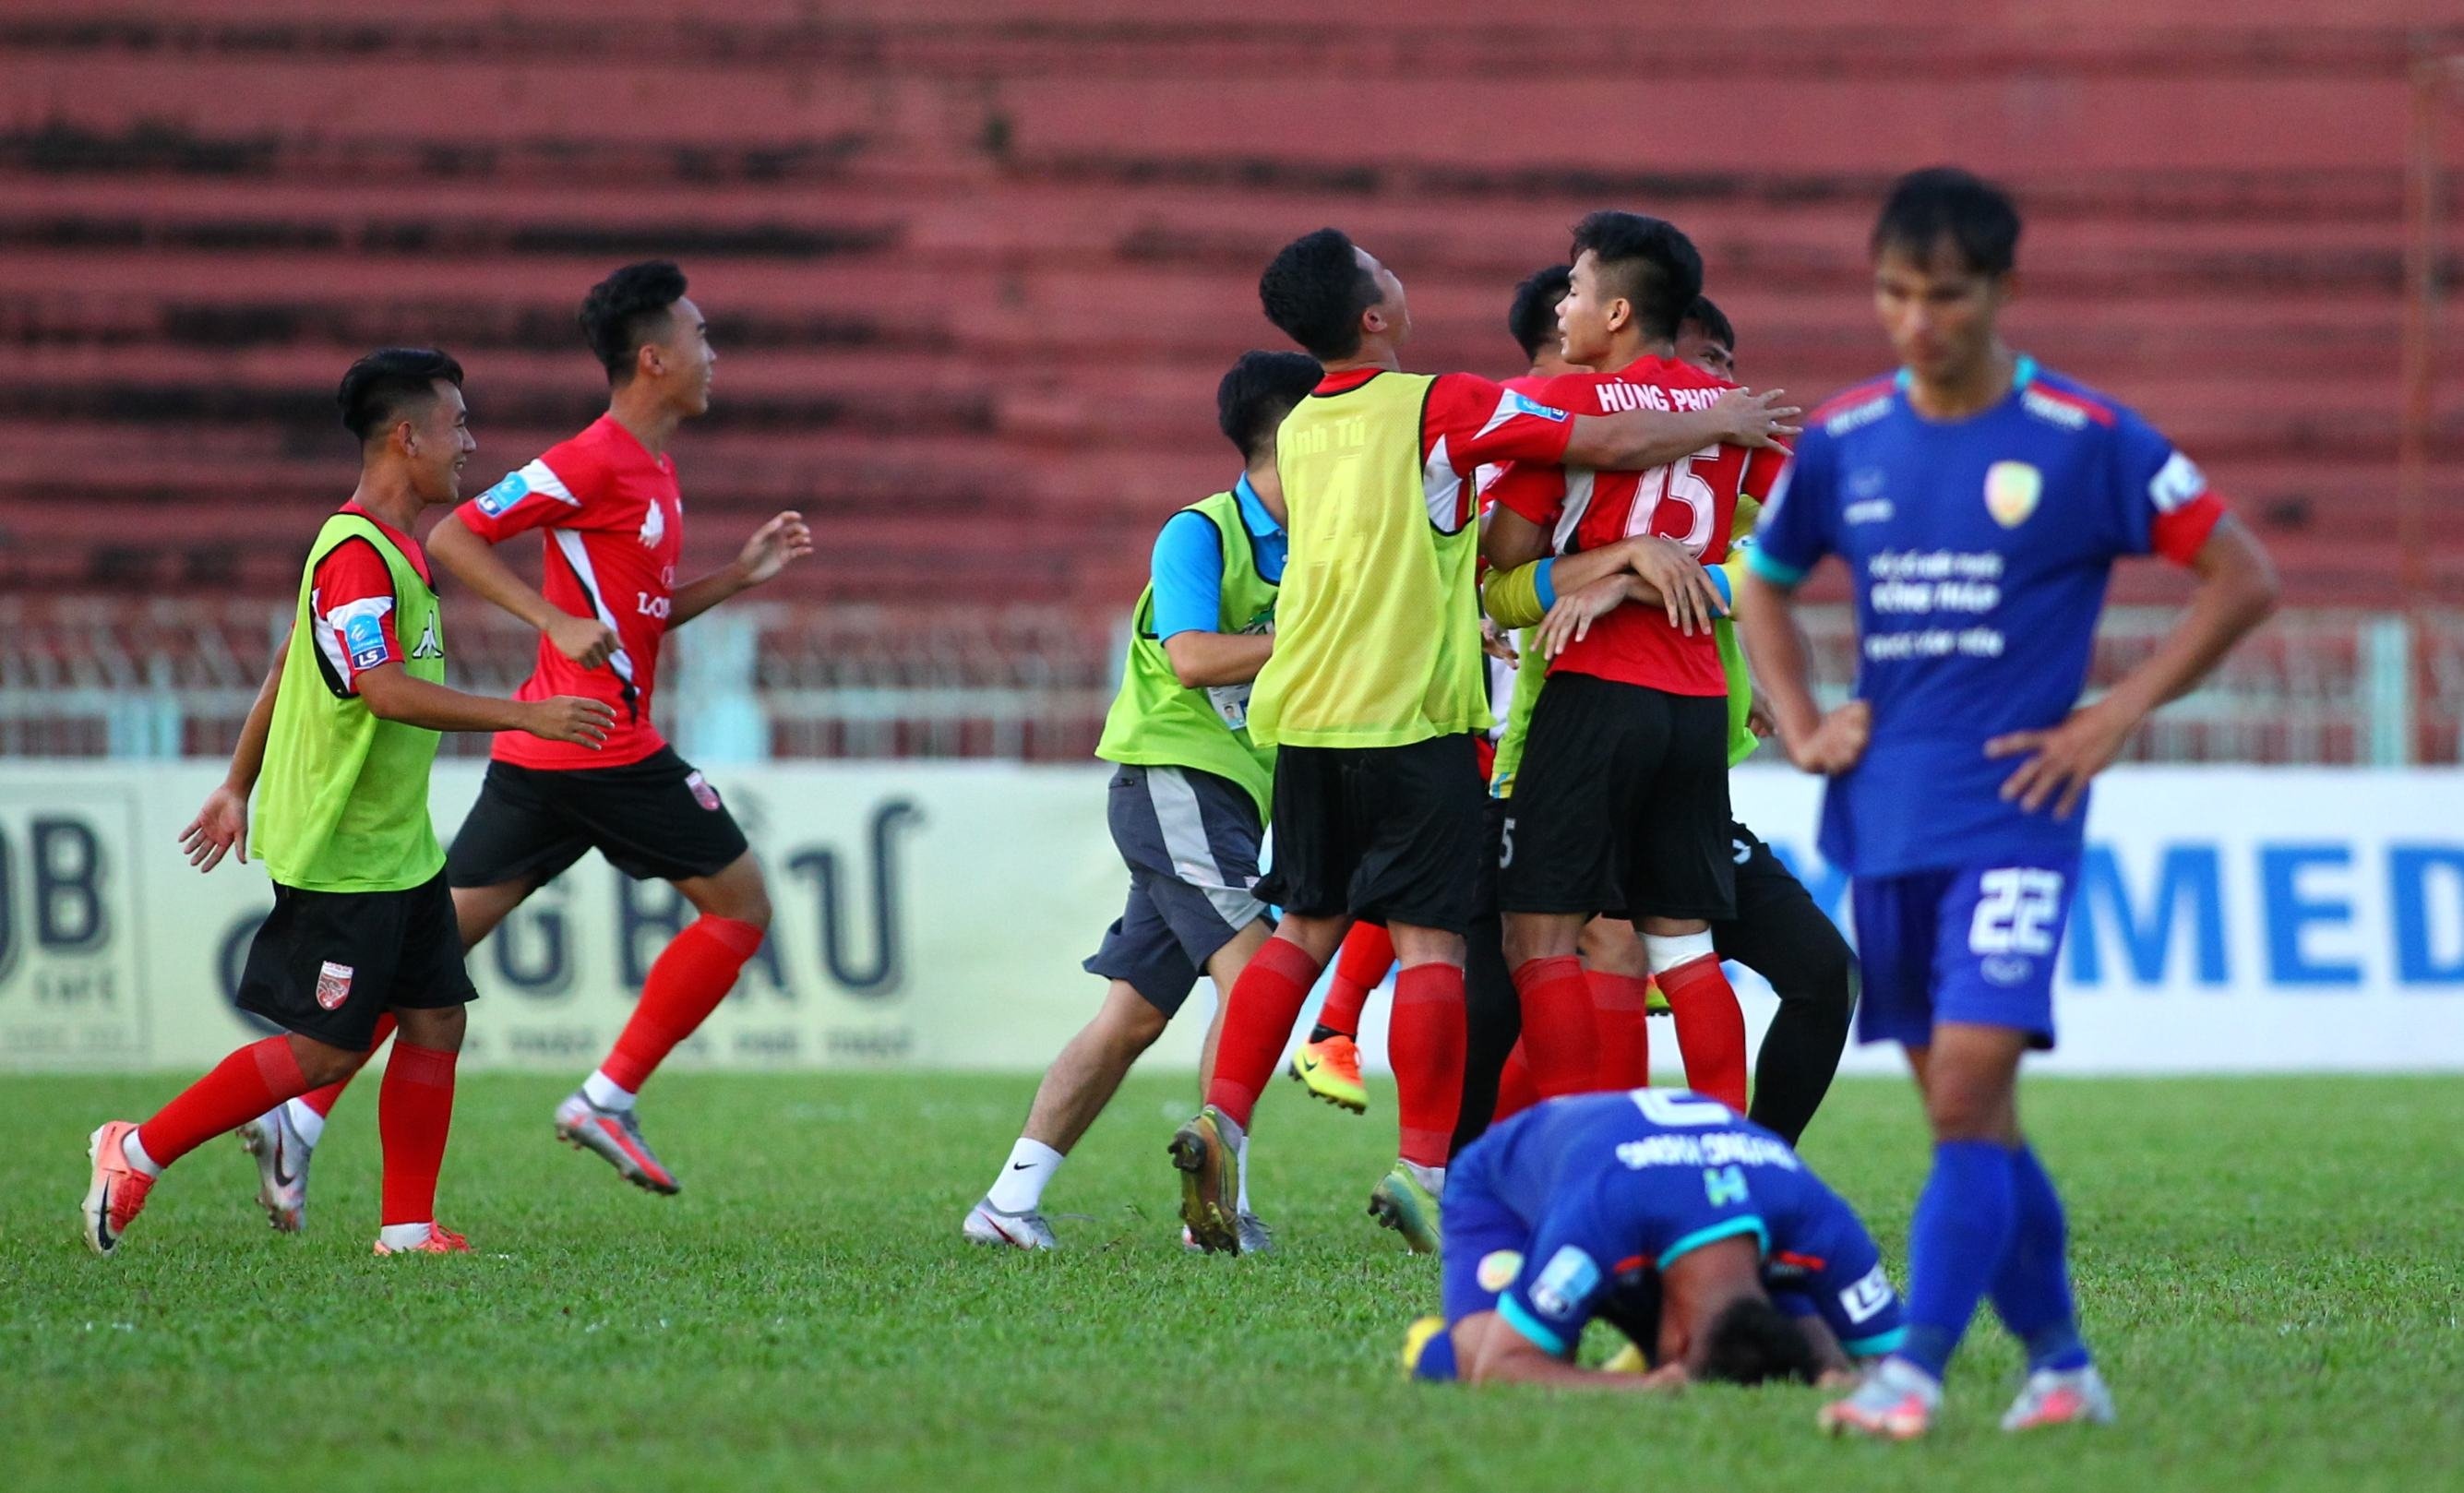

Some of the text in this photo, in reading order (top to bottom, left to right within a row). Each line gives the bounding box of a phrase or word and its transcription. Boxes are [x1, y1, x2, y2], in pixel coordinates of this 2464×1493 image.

[1595, 376, 1670, 412] HÙNG
[1623, 443, 1720, 561] 15
[358, 650, 379, 667] LS
[1968, 866, 2065, 955] 22
